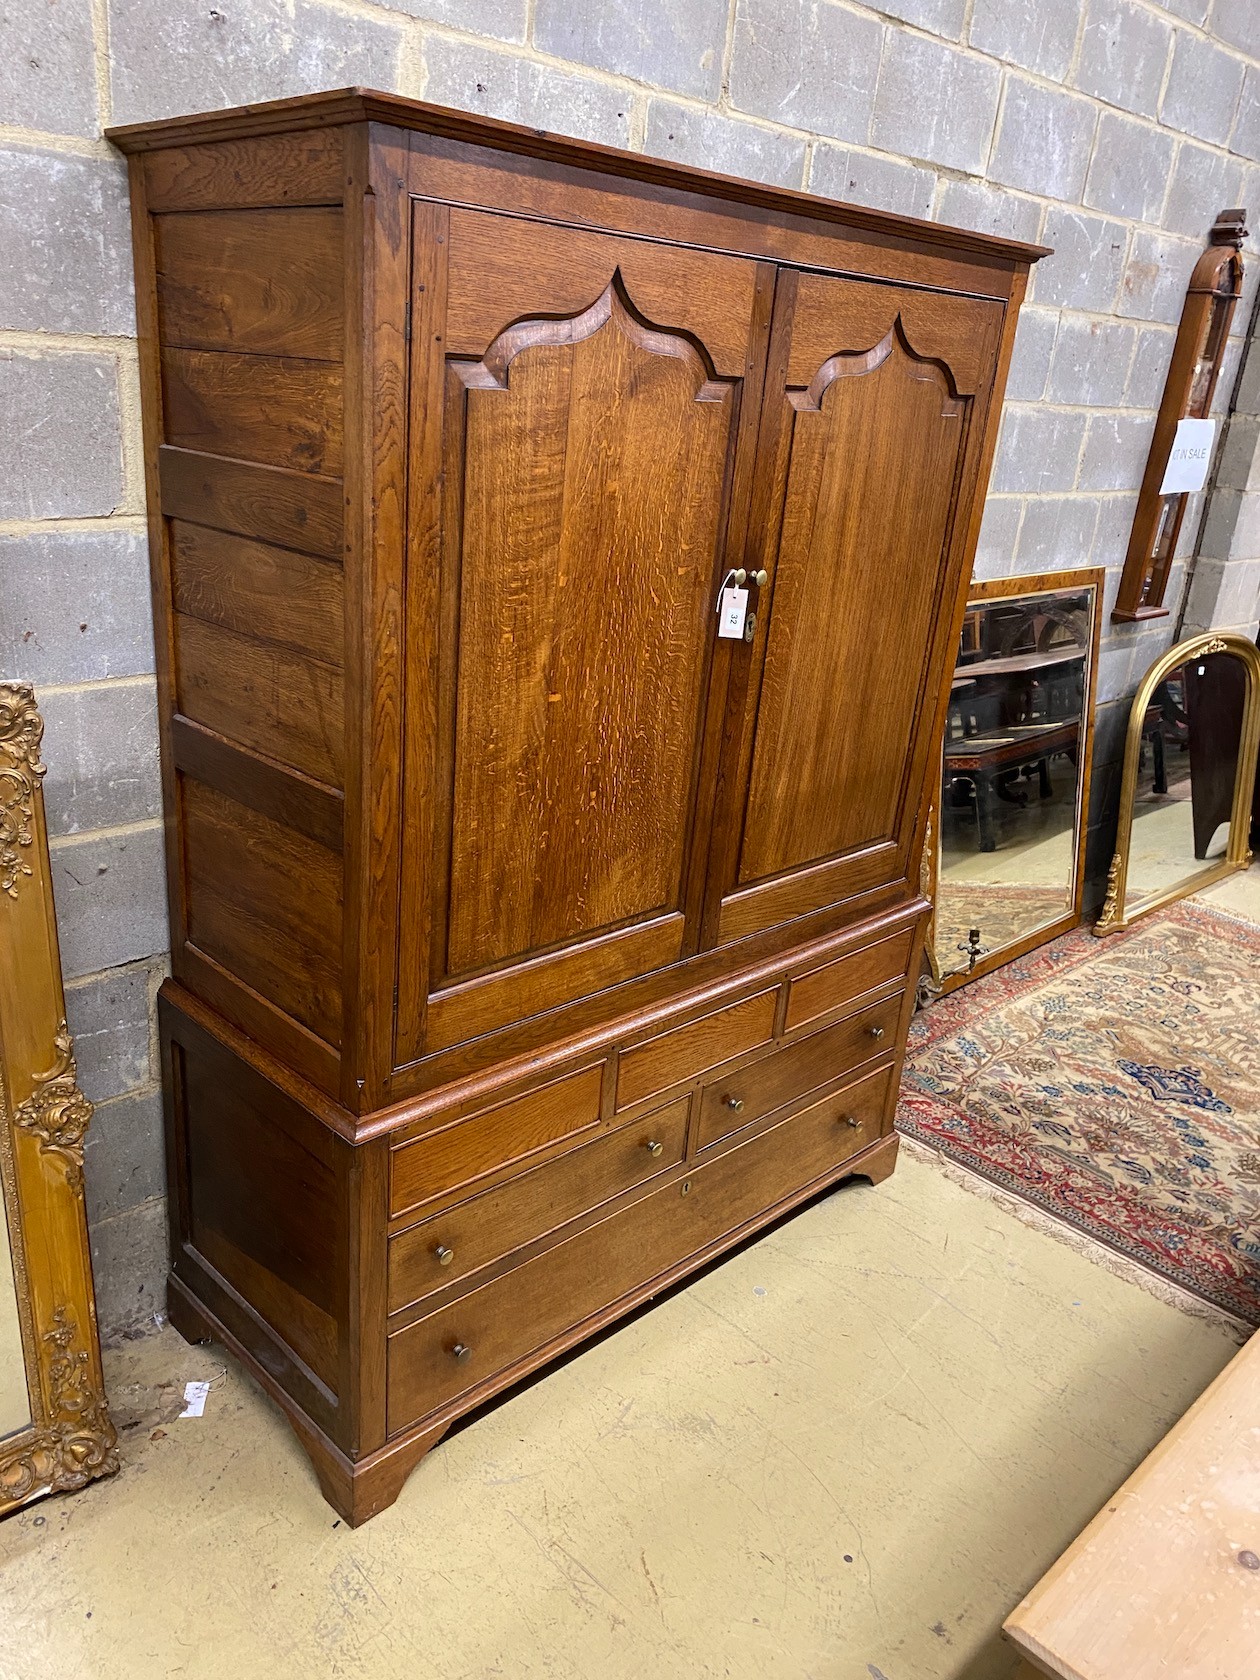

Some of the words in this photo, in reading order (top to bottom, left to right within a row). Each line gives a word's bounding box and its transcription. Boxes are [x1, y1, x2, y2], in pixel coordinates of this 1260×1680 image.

[1179, 449, 1188, 460] IN
[1188, 448, 1207, 460] SALE
[729, 613, 739, 625] 32
